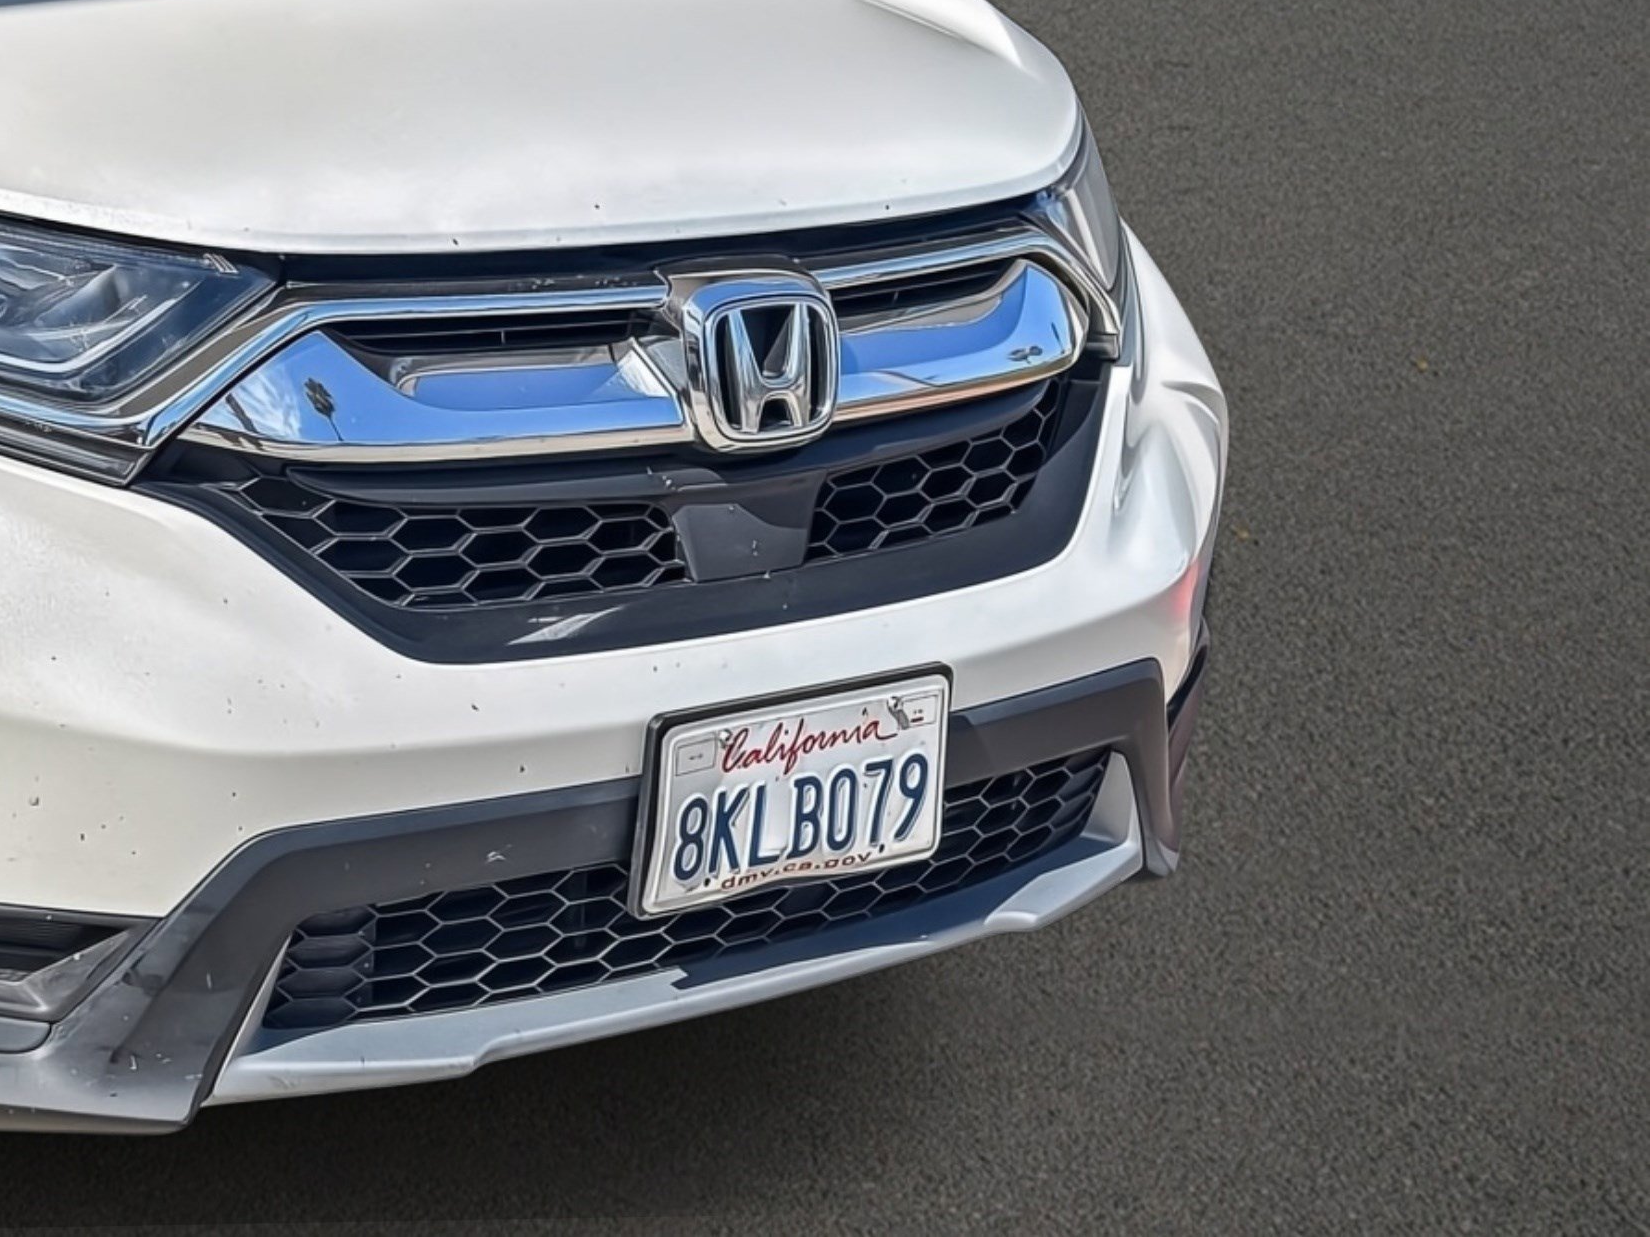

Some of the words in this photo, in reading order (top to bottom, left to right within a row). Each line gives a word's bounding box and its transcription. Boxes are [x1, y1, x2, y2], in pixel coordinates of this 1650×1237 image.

[720, 718, 897, 774] California
[675, 753, 929, 881] 8KLB079
[721, 852, 871, 890] dmv.ca.gov
